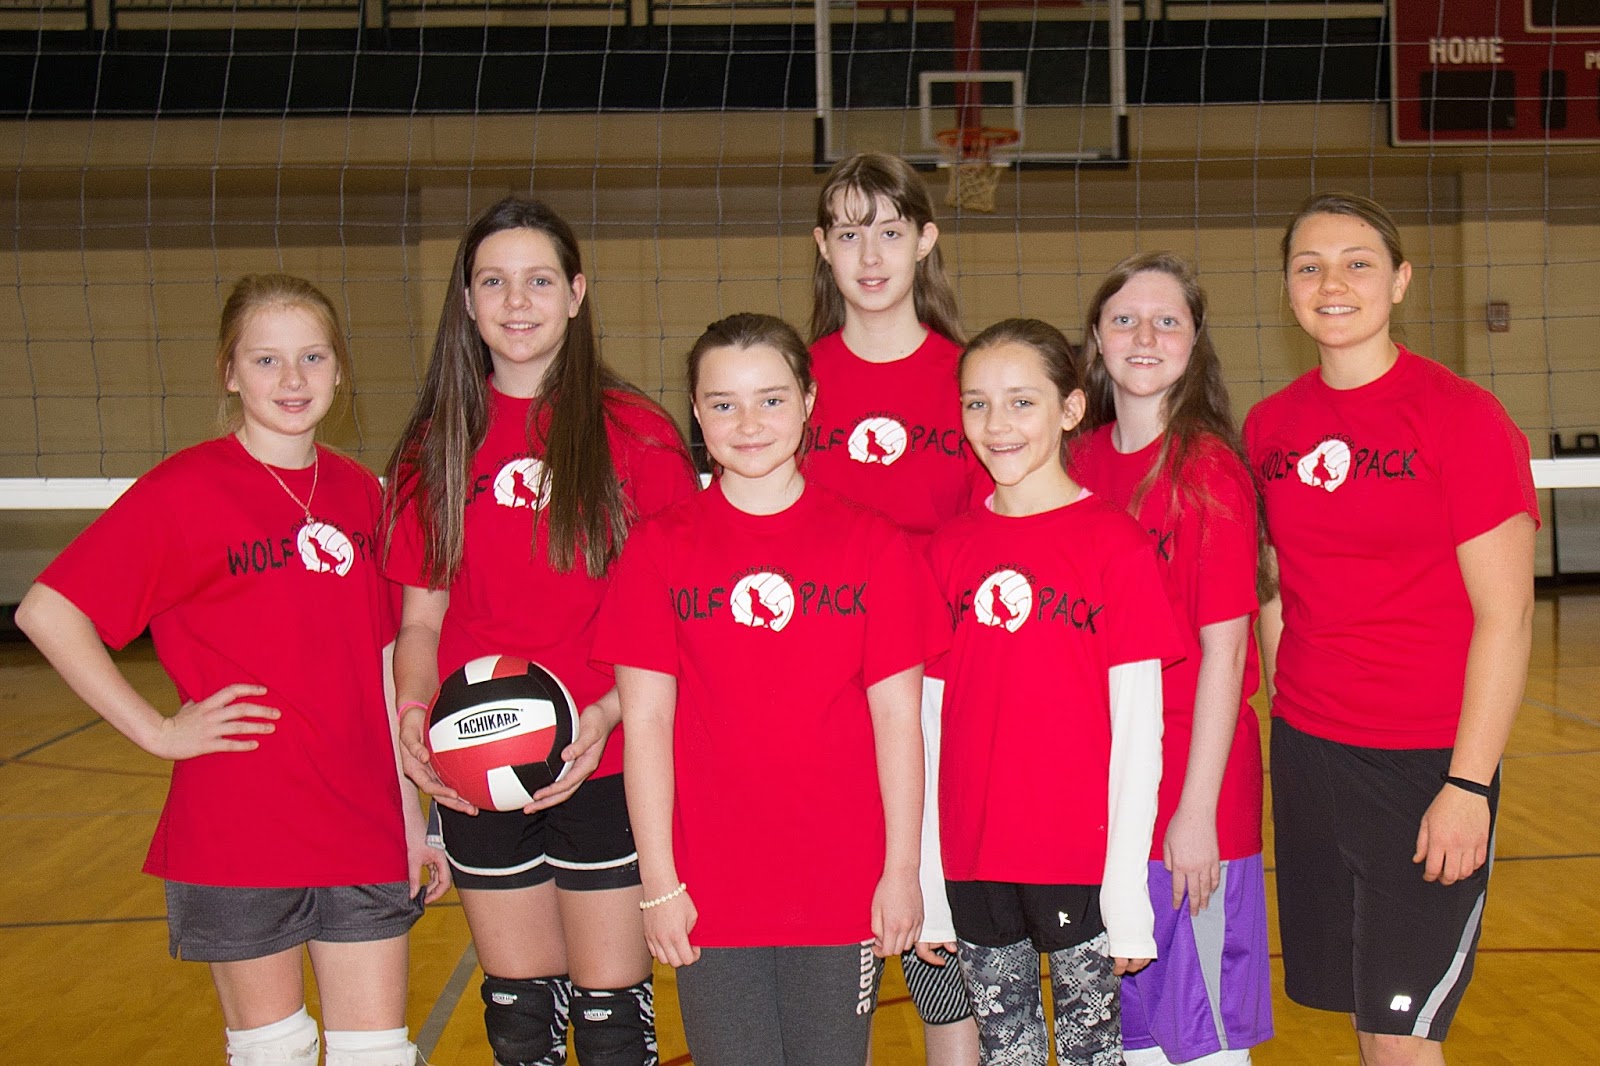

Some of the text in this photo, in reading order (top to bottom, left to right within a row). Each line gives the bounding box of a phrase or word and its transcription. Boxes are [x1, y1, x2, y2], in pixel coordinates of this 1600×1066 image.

[1429, 37, 1505, 64] HOME
[1354, 448, 1418, 480] PACK
[227, 538, 295, 576] WOLF
[729, 564, 796, 585] JUNIOR
[978, 563, 1038, 586] JUNIOR
[669, 581, 868, 622] OLF PACK
[1038, 586, 1104, 634] PACK
[455, 710, 519, 735] TACHIKARA
